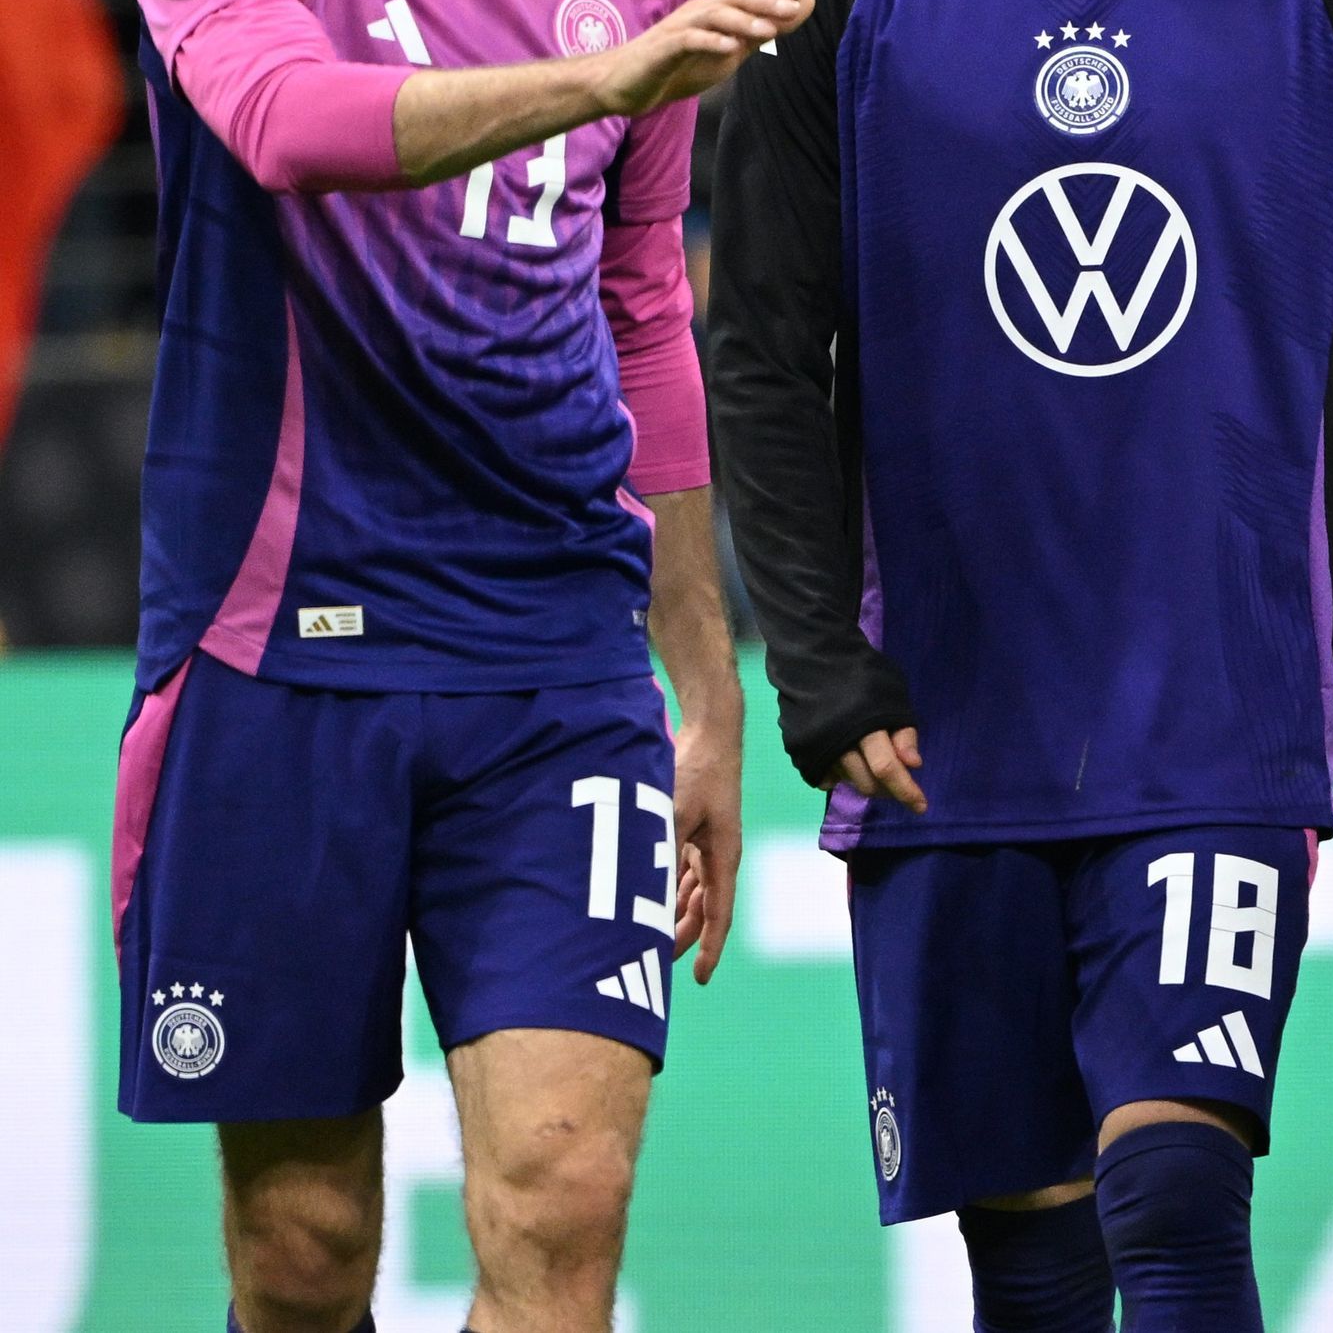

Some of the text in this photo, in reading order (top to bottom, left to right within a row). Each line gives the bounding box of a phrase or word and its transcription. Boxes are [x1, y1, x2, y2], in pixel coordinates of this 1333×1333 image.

[1056, 57, 1109, 75] DEUTSCHER
[1051, 97, 1114, 123] FUSSBALL-BUND
[571, 774, 676, 940] 13
[1147, 852, 1279, 1000] 18
